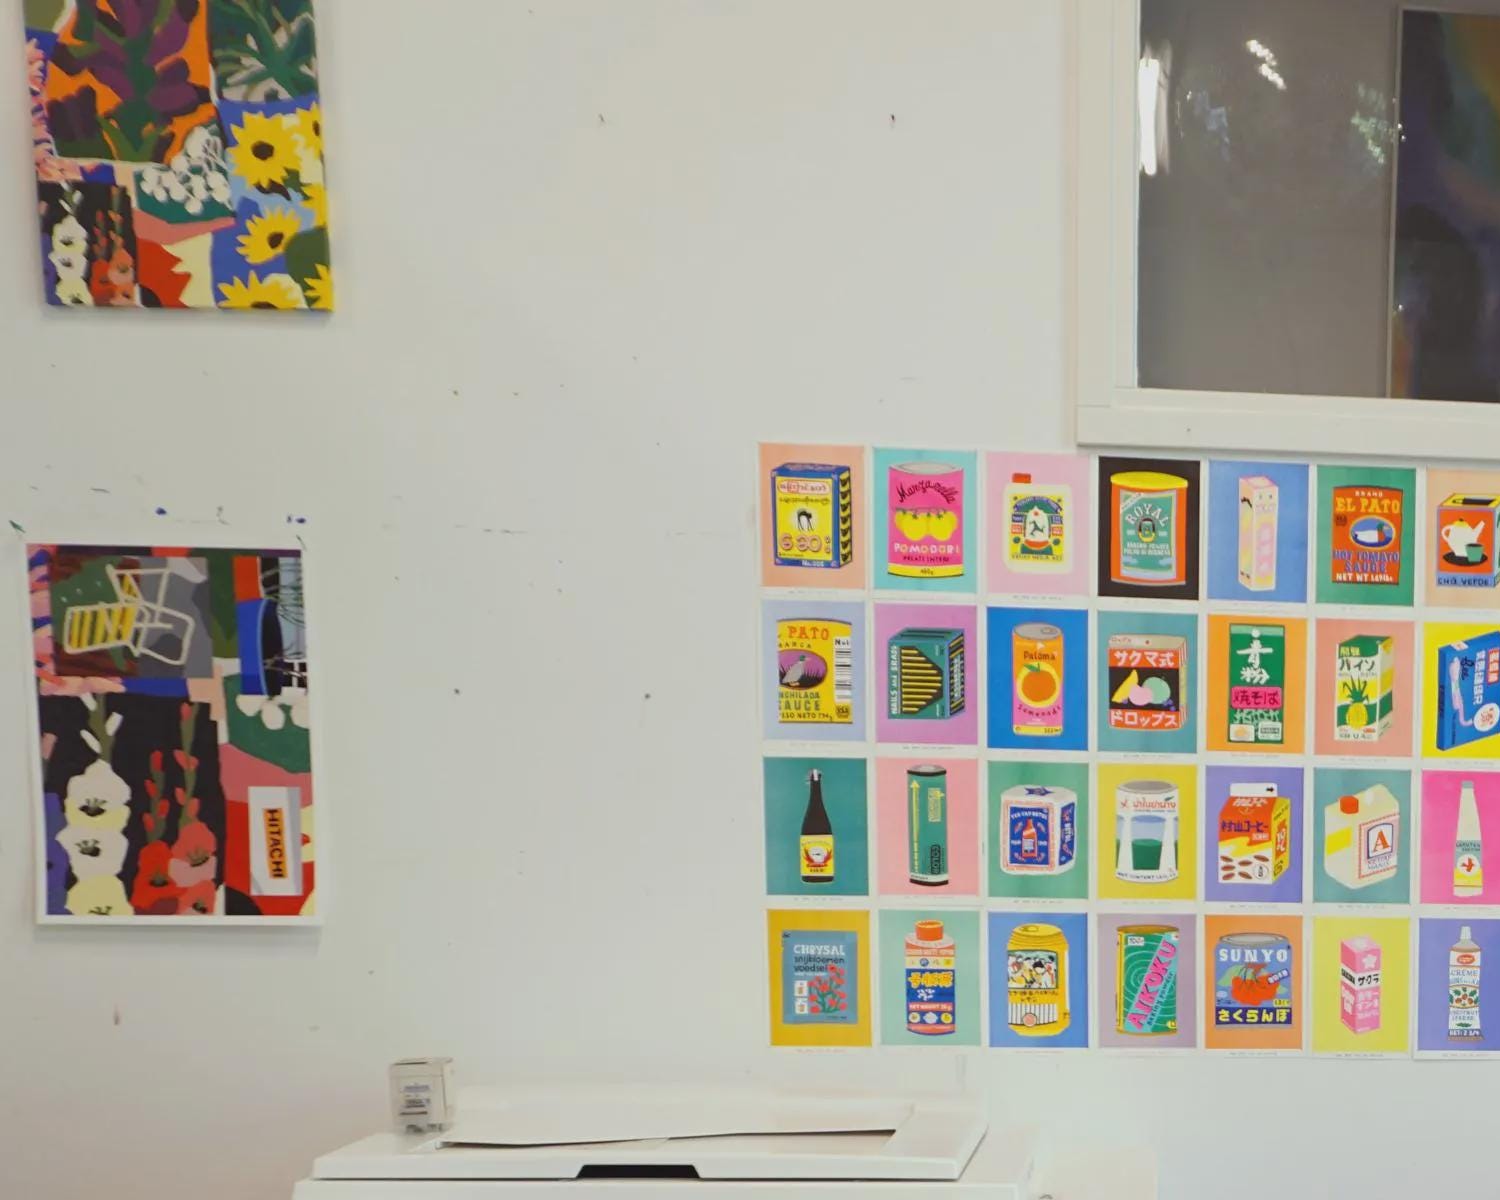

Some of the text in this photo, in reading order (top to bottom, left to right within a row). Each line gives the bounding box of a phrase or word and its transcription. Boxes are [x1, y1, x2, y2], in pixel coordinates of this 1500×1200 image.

[1335, 497, 1400, 514] EL PATO
[1125, 503, 1170, 527] ROYAL
[894, 543, 960, 555] POMODORI
[1335, 572, 1370, 582] NET WT
[788, 625, 830, 641] PATO
[1114, 649, 1175, 668] サクマ式
[1232, 689, 1280, 706] 焼そば
[1109, 709, 1179, 728] ドロップス
[264, 807, 288, 879] HITACHI
[1373, 830, 1391, 853] A
[793, 944, 846, 956] CHRYSAL
[1218, 948, 1289, 963] SUNYO
